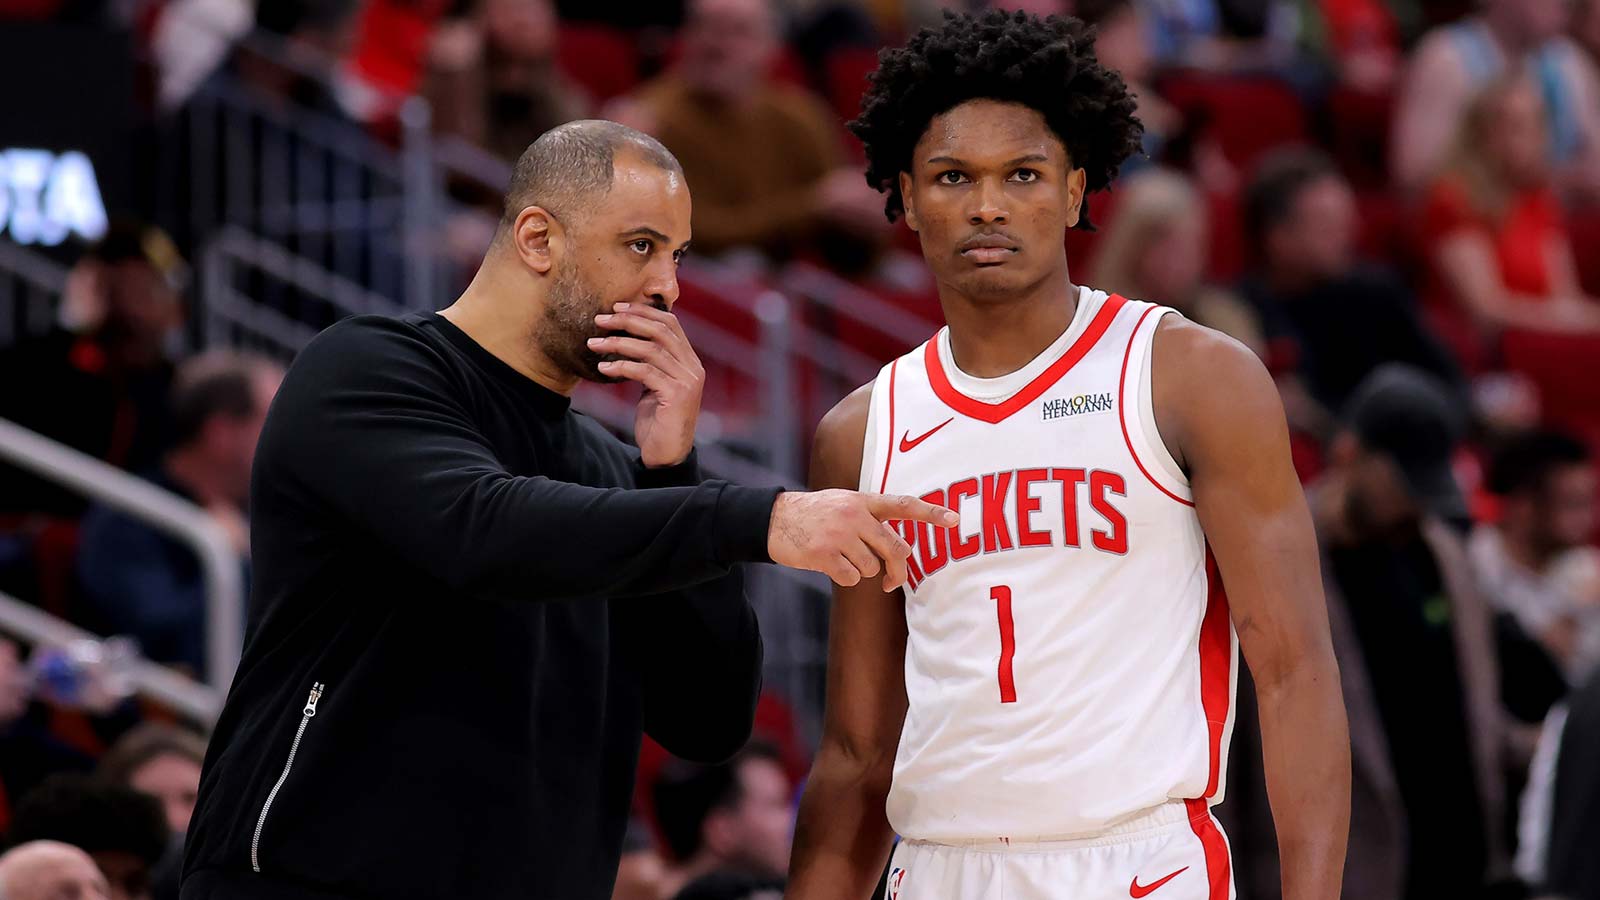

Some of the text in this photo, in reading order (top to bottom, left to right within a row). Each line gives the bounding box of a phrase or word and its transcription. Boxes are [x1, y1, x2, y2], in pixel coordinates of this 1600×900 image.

[0, 148, 109, 245] TA
[1043, 392, 1113, 412] MEMORIAL
[1043, 400, 1113, 420] HERMANN
[990, 585, 1017, 703] 1
